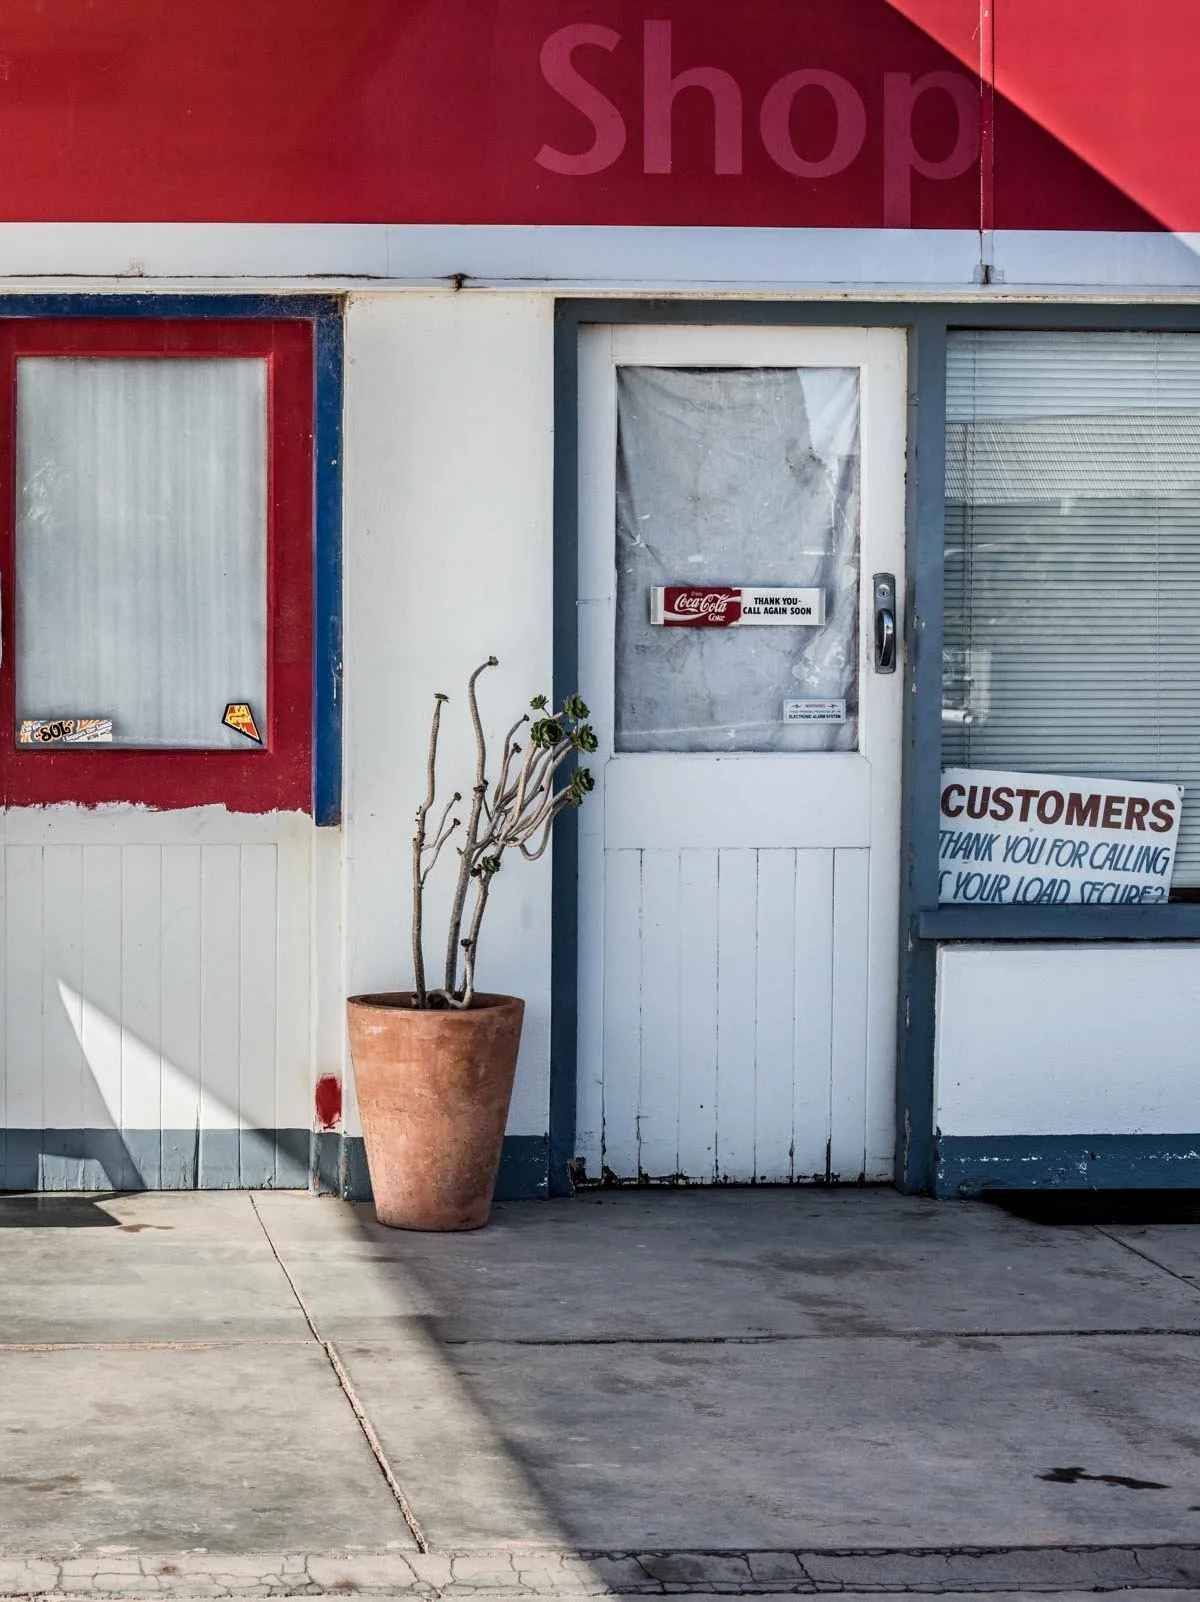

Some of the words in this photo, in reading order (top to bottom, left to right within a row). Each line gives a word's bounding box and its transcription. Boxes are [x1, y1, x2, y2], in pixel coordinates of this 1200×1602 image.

[534, 19, 981, 228] Shop
[674, 593, 729, 612] Coca-Cola
[941, 783, 1175, 833] CUSTOMERS
[939, 830, 1000, 862] THANK
[1002, 835, 1047, 865] YOU
[1045, 838, 1090, 868] FOR
[1090, 842, 1170, 876] CALLING
[954, 872, 1010, 902] YOUR
[1012, 876, 1071, 904] LOAD
[1080, 880, 1165, 904] SECURE?
